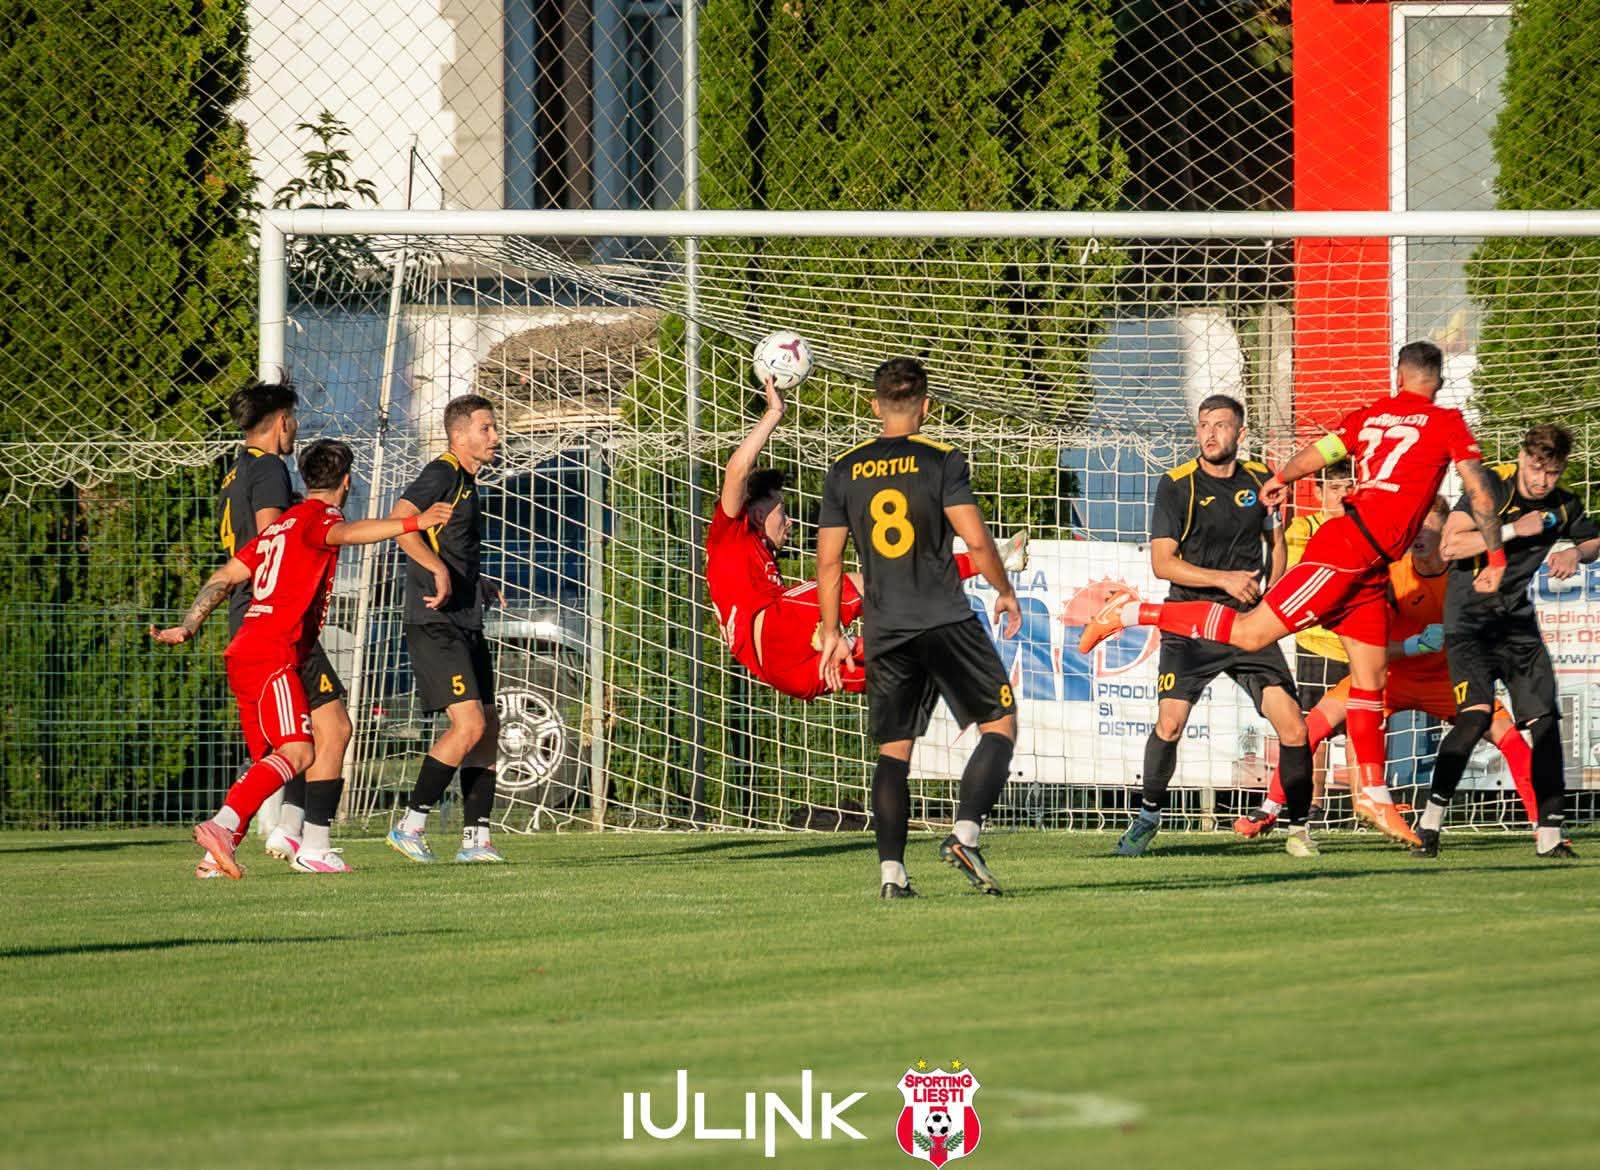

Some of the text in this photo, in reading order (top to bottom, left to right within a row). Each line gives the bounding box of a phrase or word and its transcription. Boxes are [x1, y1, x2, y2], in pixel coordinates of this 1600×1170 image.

[851, 455, 920, 481] PORTUL
[219, 497, 236, 557] 4
[870, 488, 915, 559] 8
[253, 533, 286, 601] 20
[1542, 630, 1572, 643] el.:
[319, 673, 335, 693] 4
[451, 674, 466, 697] 5
[1157, 672, 1176, 693] 20
[999, 683, 1013, 708] 8
[1098, 702, 1114, 717] SI
